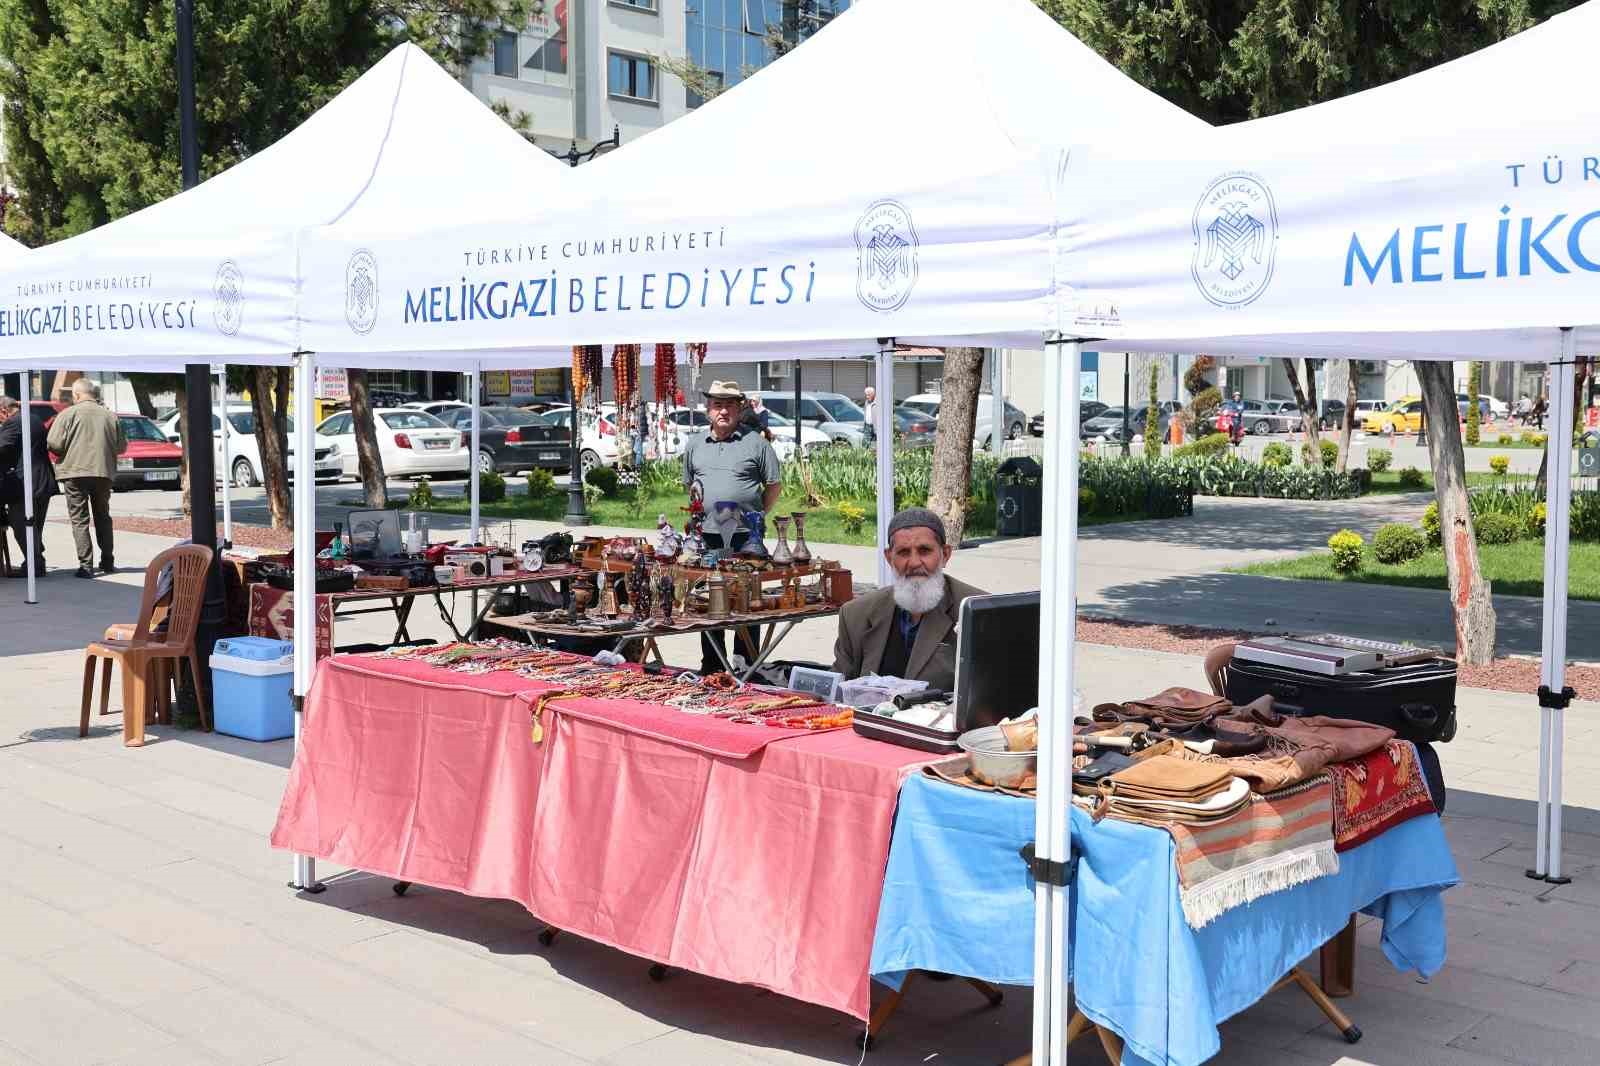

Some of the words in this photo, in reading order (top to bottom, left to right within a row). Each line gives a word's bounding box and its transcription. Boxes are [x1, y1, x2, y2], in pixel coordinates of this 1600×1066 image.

[463, 243, 548, 266] TÜRKİYE
[561, 226, 726, 258] CUMHURİYETİ
[17, 280, 62, 297] TÜRKİYE
[69, 272, 152, 291] CUMHURİYETİ
[403, 268, 557, 324] MELİKGAZİ
[569, 260, 816, 313] BELEDİYESİ
[73, 299, 196, 331] BELEDİYESİ
